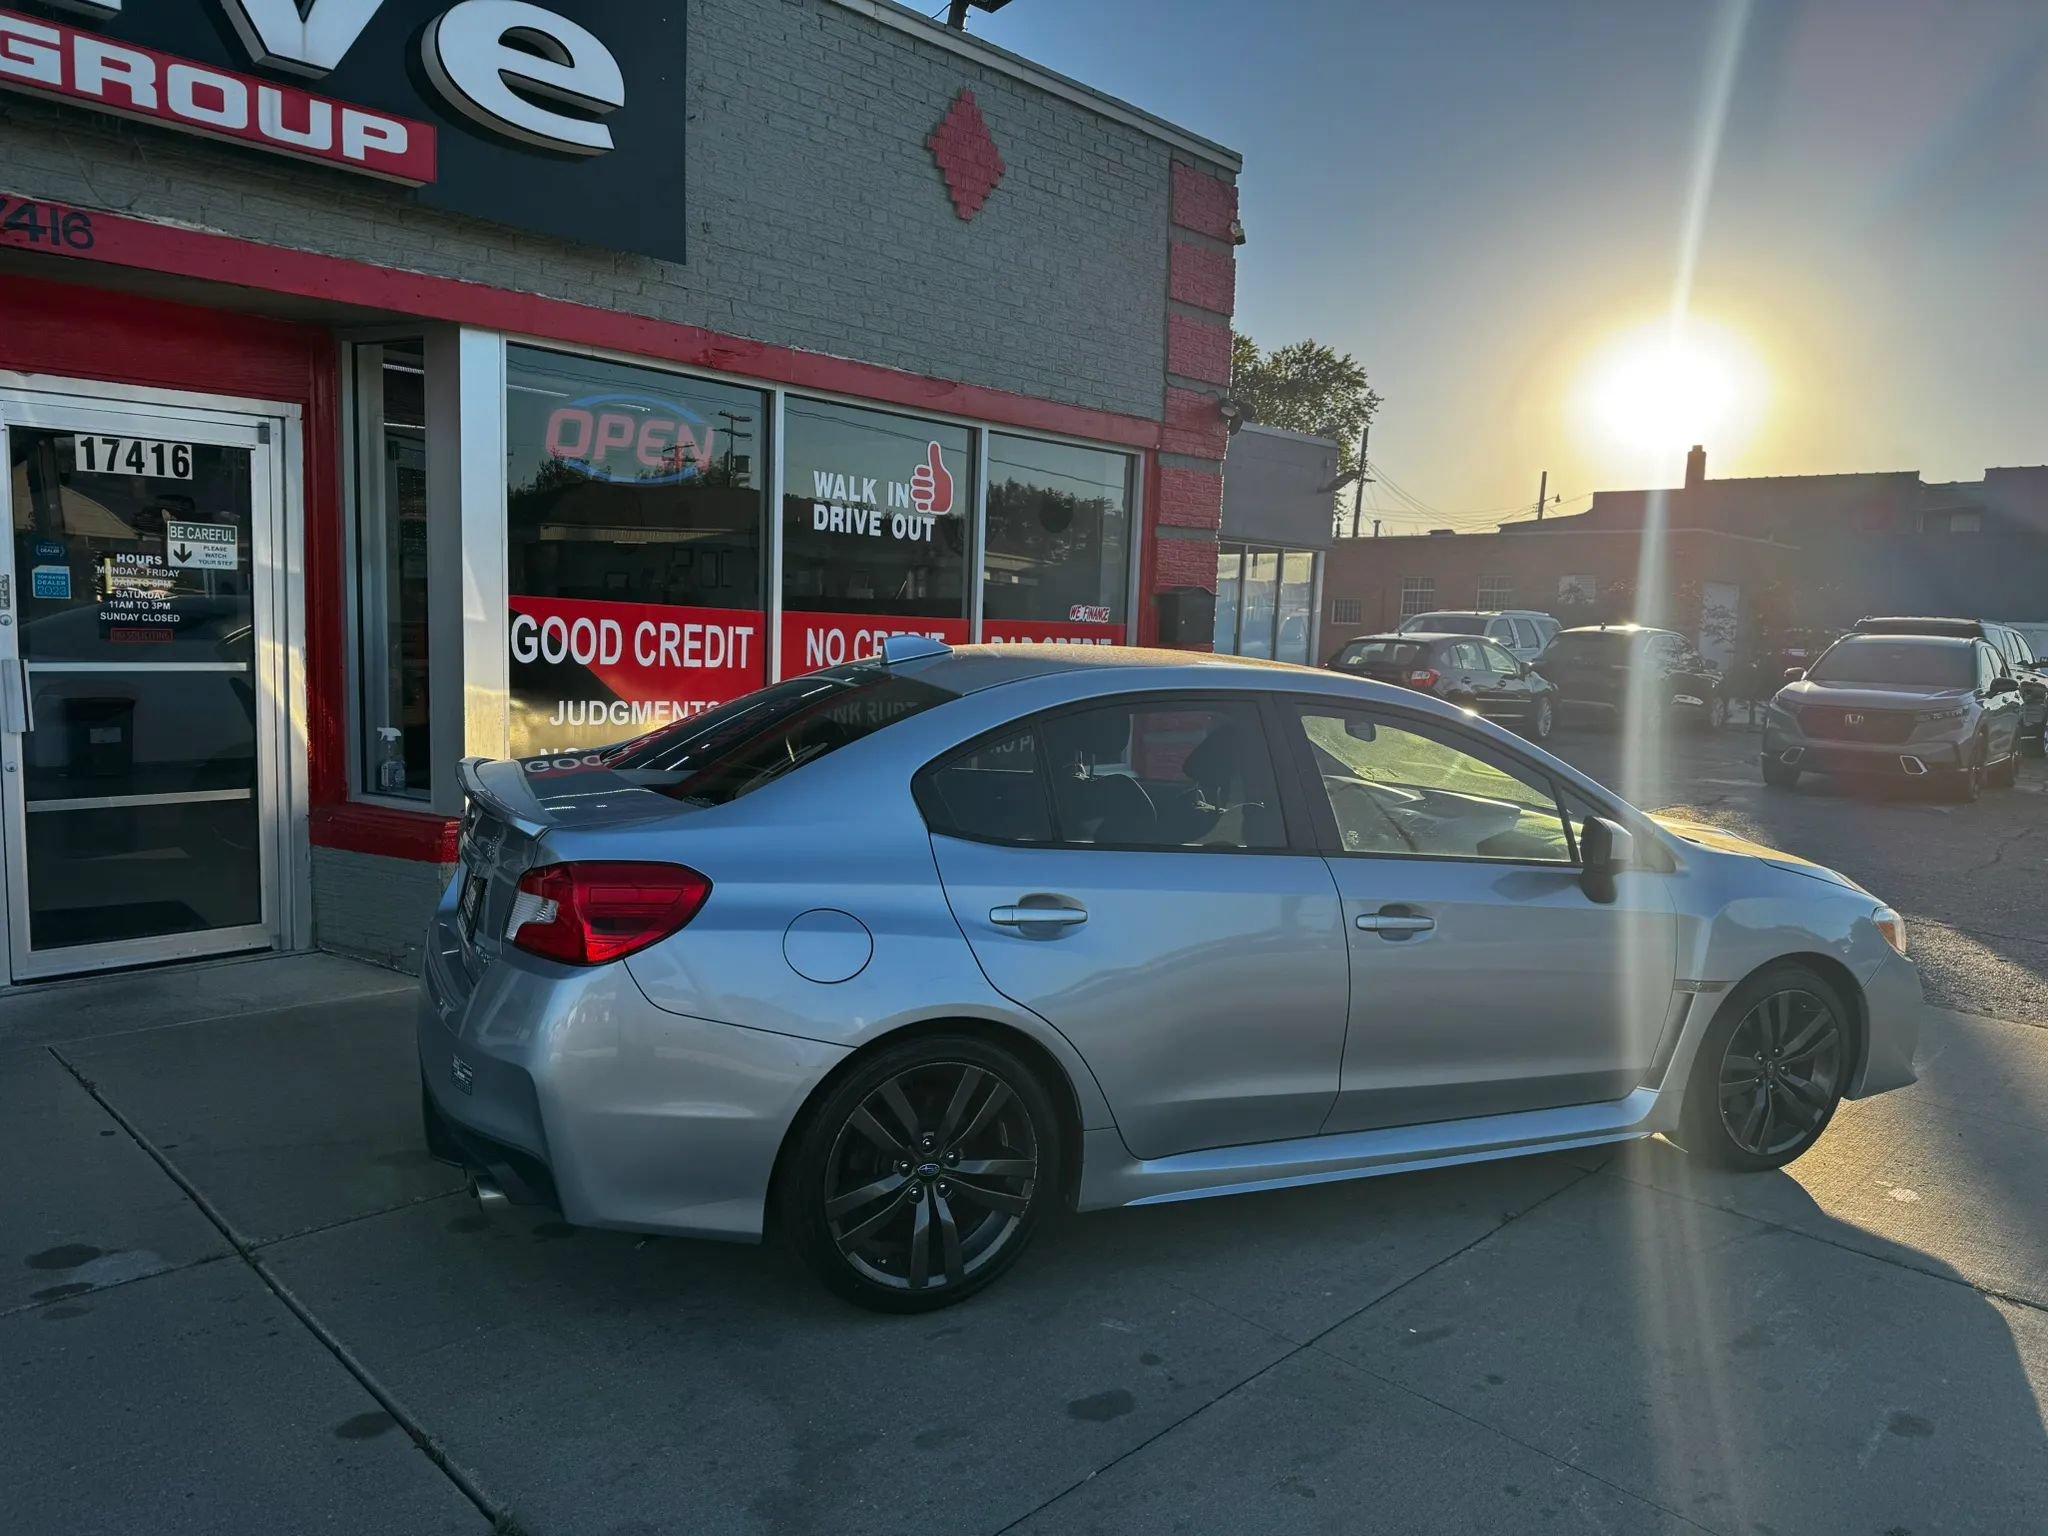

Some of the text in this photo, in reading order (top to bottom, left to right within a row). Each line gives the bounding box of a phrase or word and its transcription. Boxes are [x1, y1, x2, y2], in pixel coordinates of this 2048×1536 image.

[0, 15, 408, 162] GROUP
[88, 0, 625, 154] ve
[0, 197, 95, 250] 416
[80, 437, 190, 478] 17416
[546, 408, 716, 472] OPEN
[813, 470, 909, 508] WALK IN
[170, 526, 235, 542] BE CAREFUL
[813, 504, 935, 542] DRIVE OUT
[116, 553, 162, 565] HOURS
[146, 568, 180, 577] FRIDAY
[109, 601, 171, 610] 11AM TO 3PM
[116, 590, 165, 600] SATURDAY
[1070, 605, 1110, 623] WE FINANCE
[100, 612, 180, 622] SUNDAY CLOSED
[511, 614, 754, 669] GOOD CREDIT
[806, 628, 846, 666] NO
